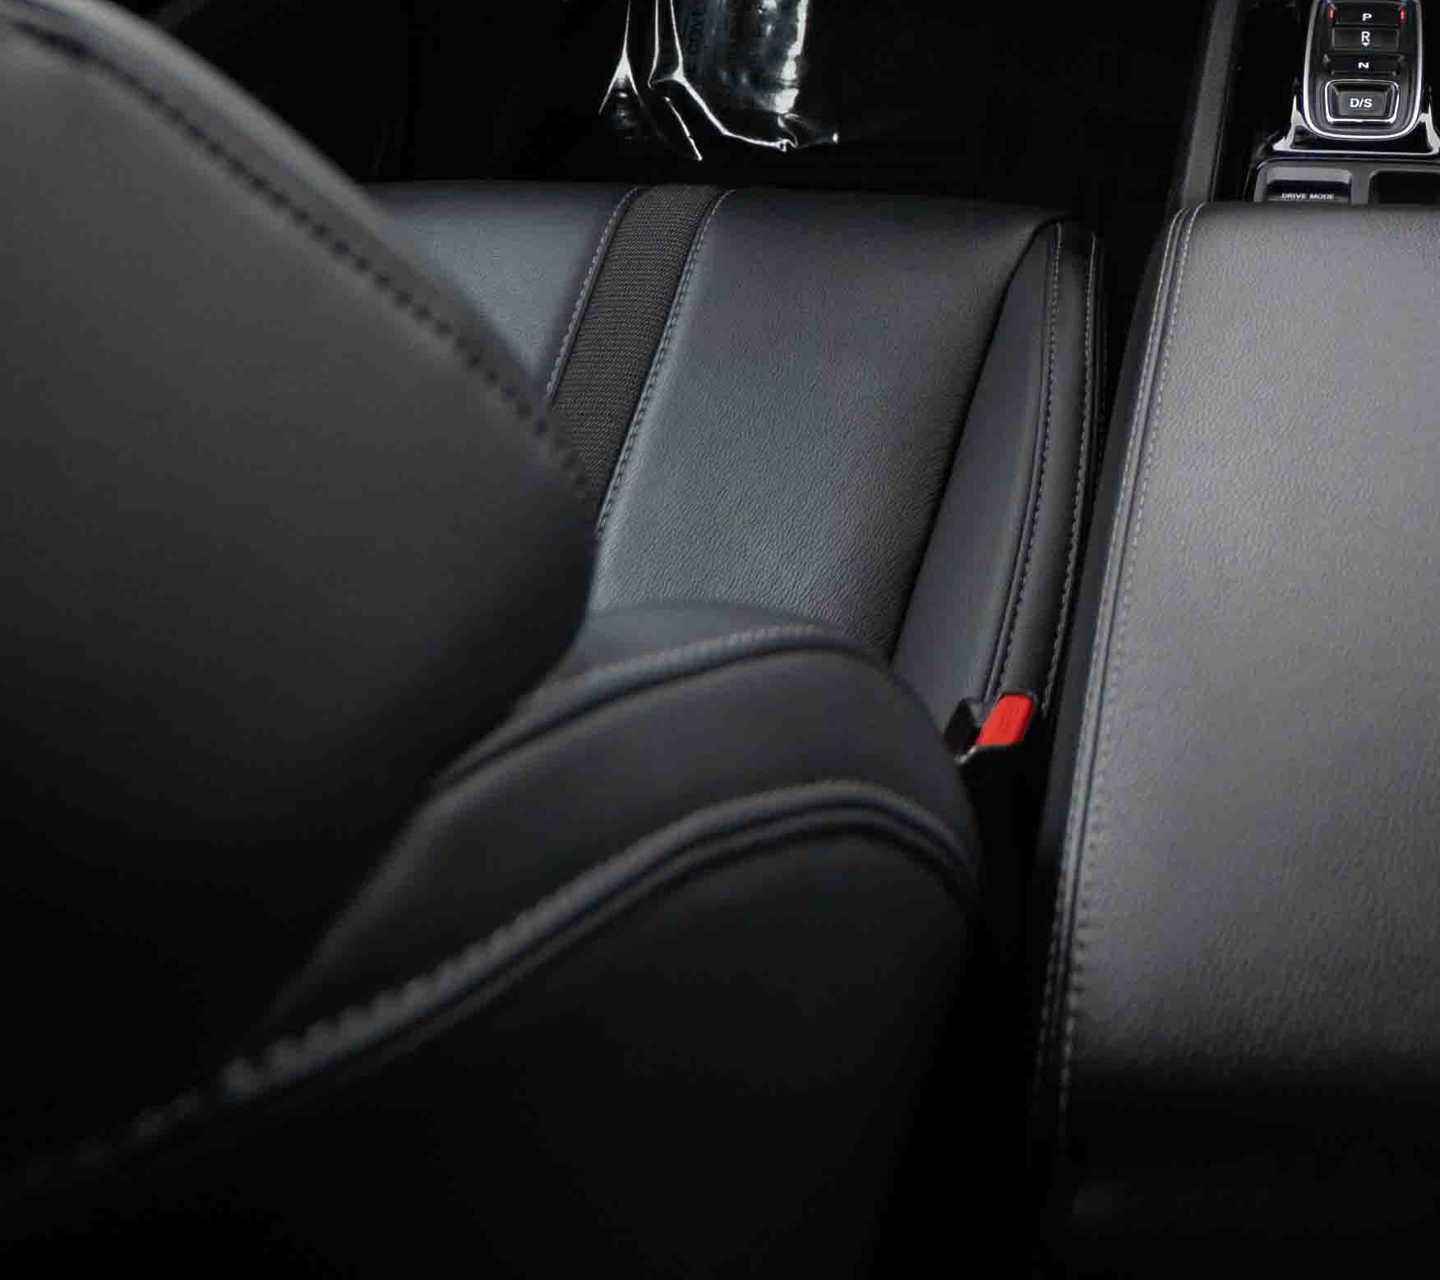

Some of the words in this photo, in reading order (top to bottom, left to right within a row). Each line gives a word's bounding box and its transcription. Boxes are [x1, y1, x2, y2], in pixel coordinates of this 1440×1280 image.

[1361, 12, 1373, 22] P
[1360, 30, 1371, 42] R
[1357, 61, 1370, 70] N
[1349, 97, 1373, 108] D/S
[1280, 192, 1307, 200] DRIVE
[1308, 192, 1335, 200] MODE
